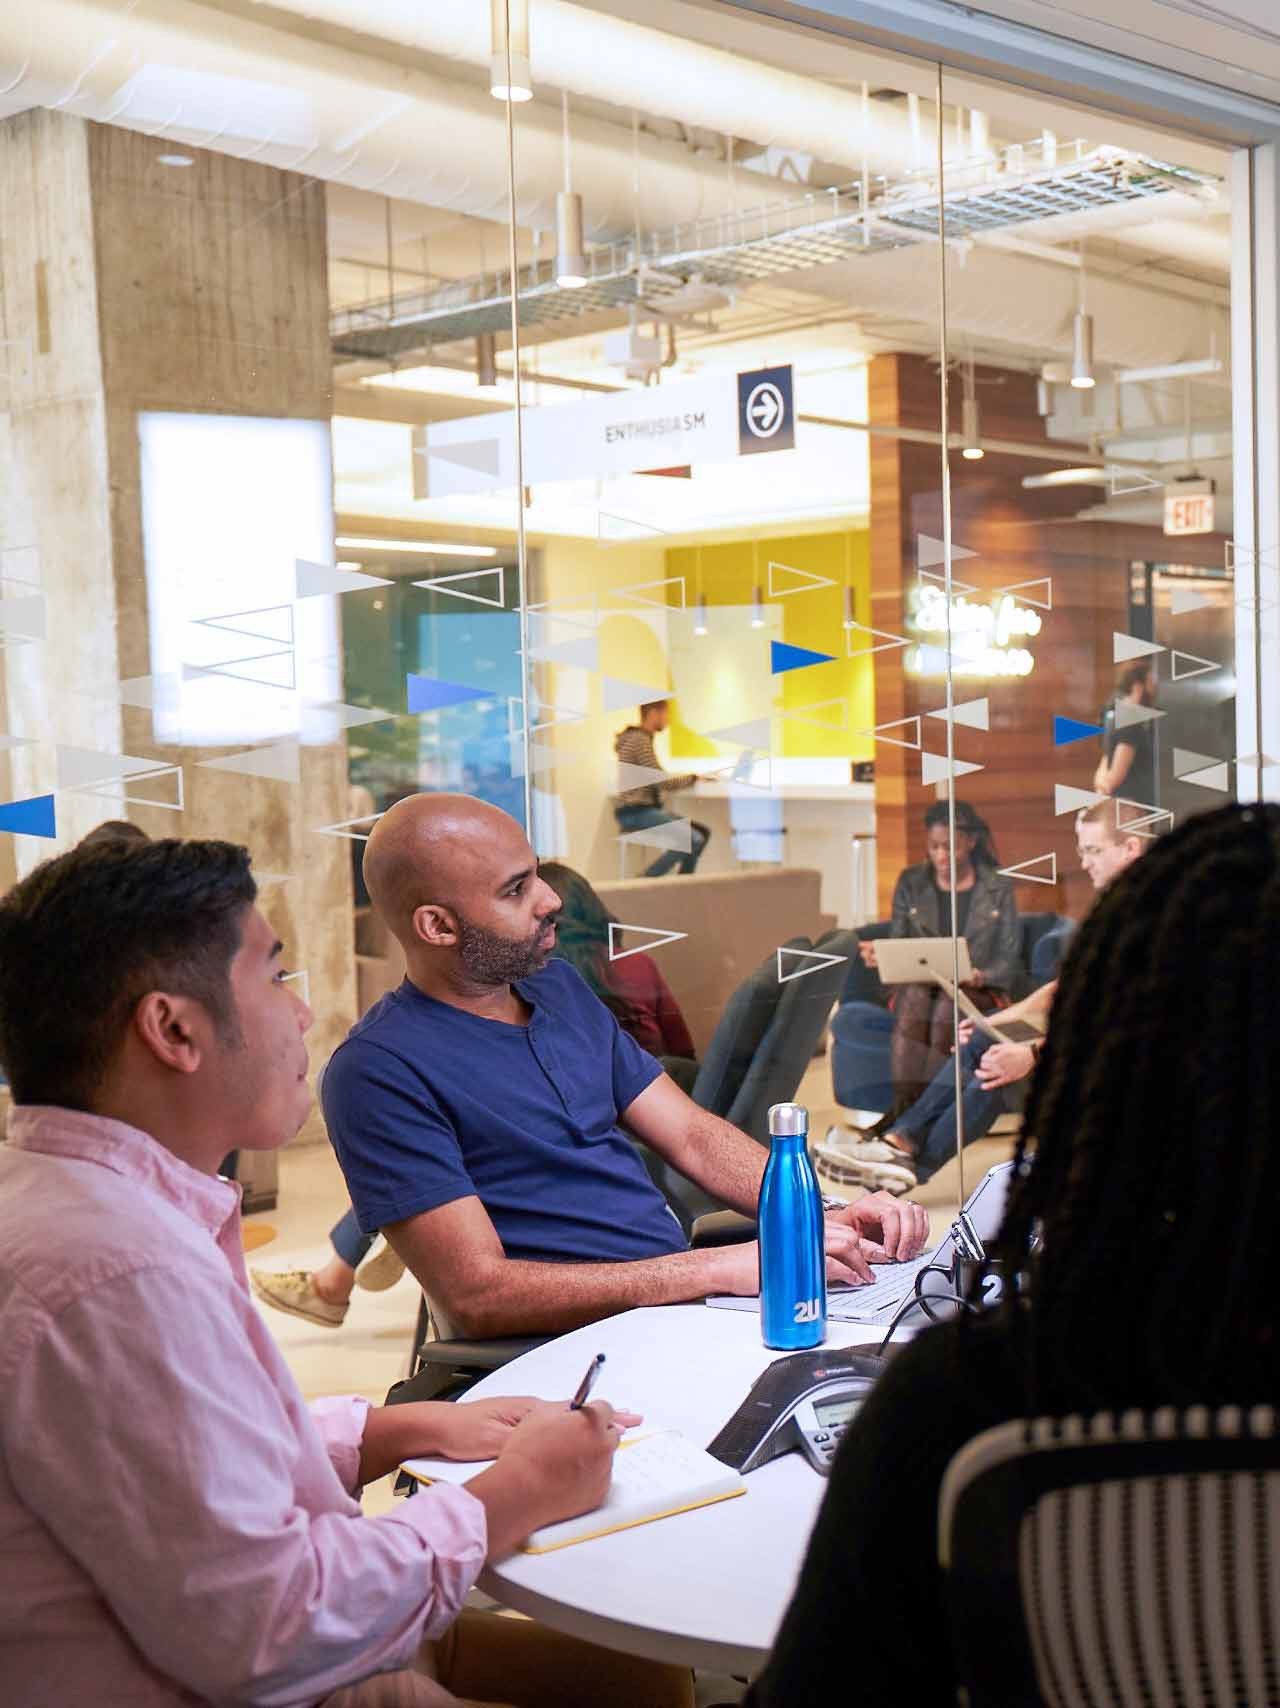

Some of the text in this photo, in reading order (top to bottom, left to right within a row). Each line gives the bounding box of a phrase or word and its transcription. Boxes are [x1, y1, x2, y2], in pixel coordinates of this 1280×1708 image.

[606, 411, 705, 443] ENTHUSIASM
[1173, 499, 1208, 530] EXIT
[793, 1297, 820, 1323] 2U
